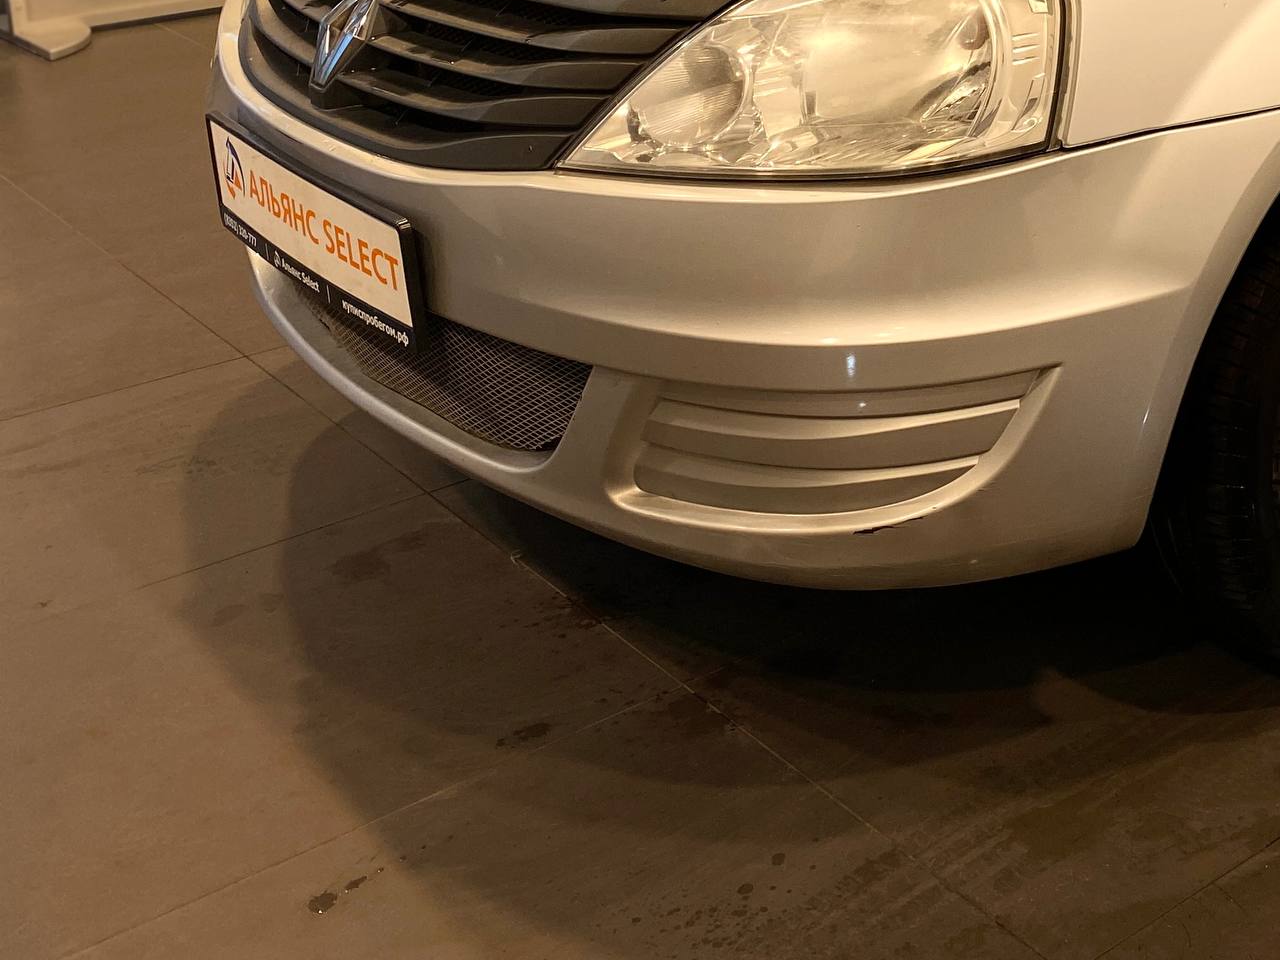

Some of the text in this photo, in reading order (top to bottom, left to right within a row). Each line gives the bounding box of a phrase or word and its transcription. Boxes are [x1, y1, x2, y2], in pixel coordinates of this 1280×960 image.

[249, 169, 400, 291] АЛЬЯНС SELECT
[302, 271, 321, 293] Select
[341, 299, 409, 347] куписпробегом.рф
